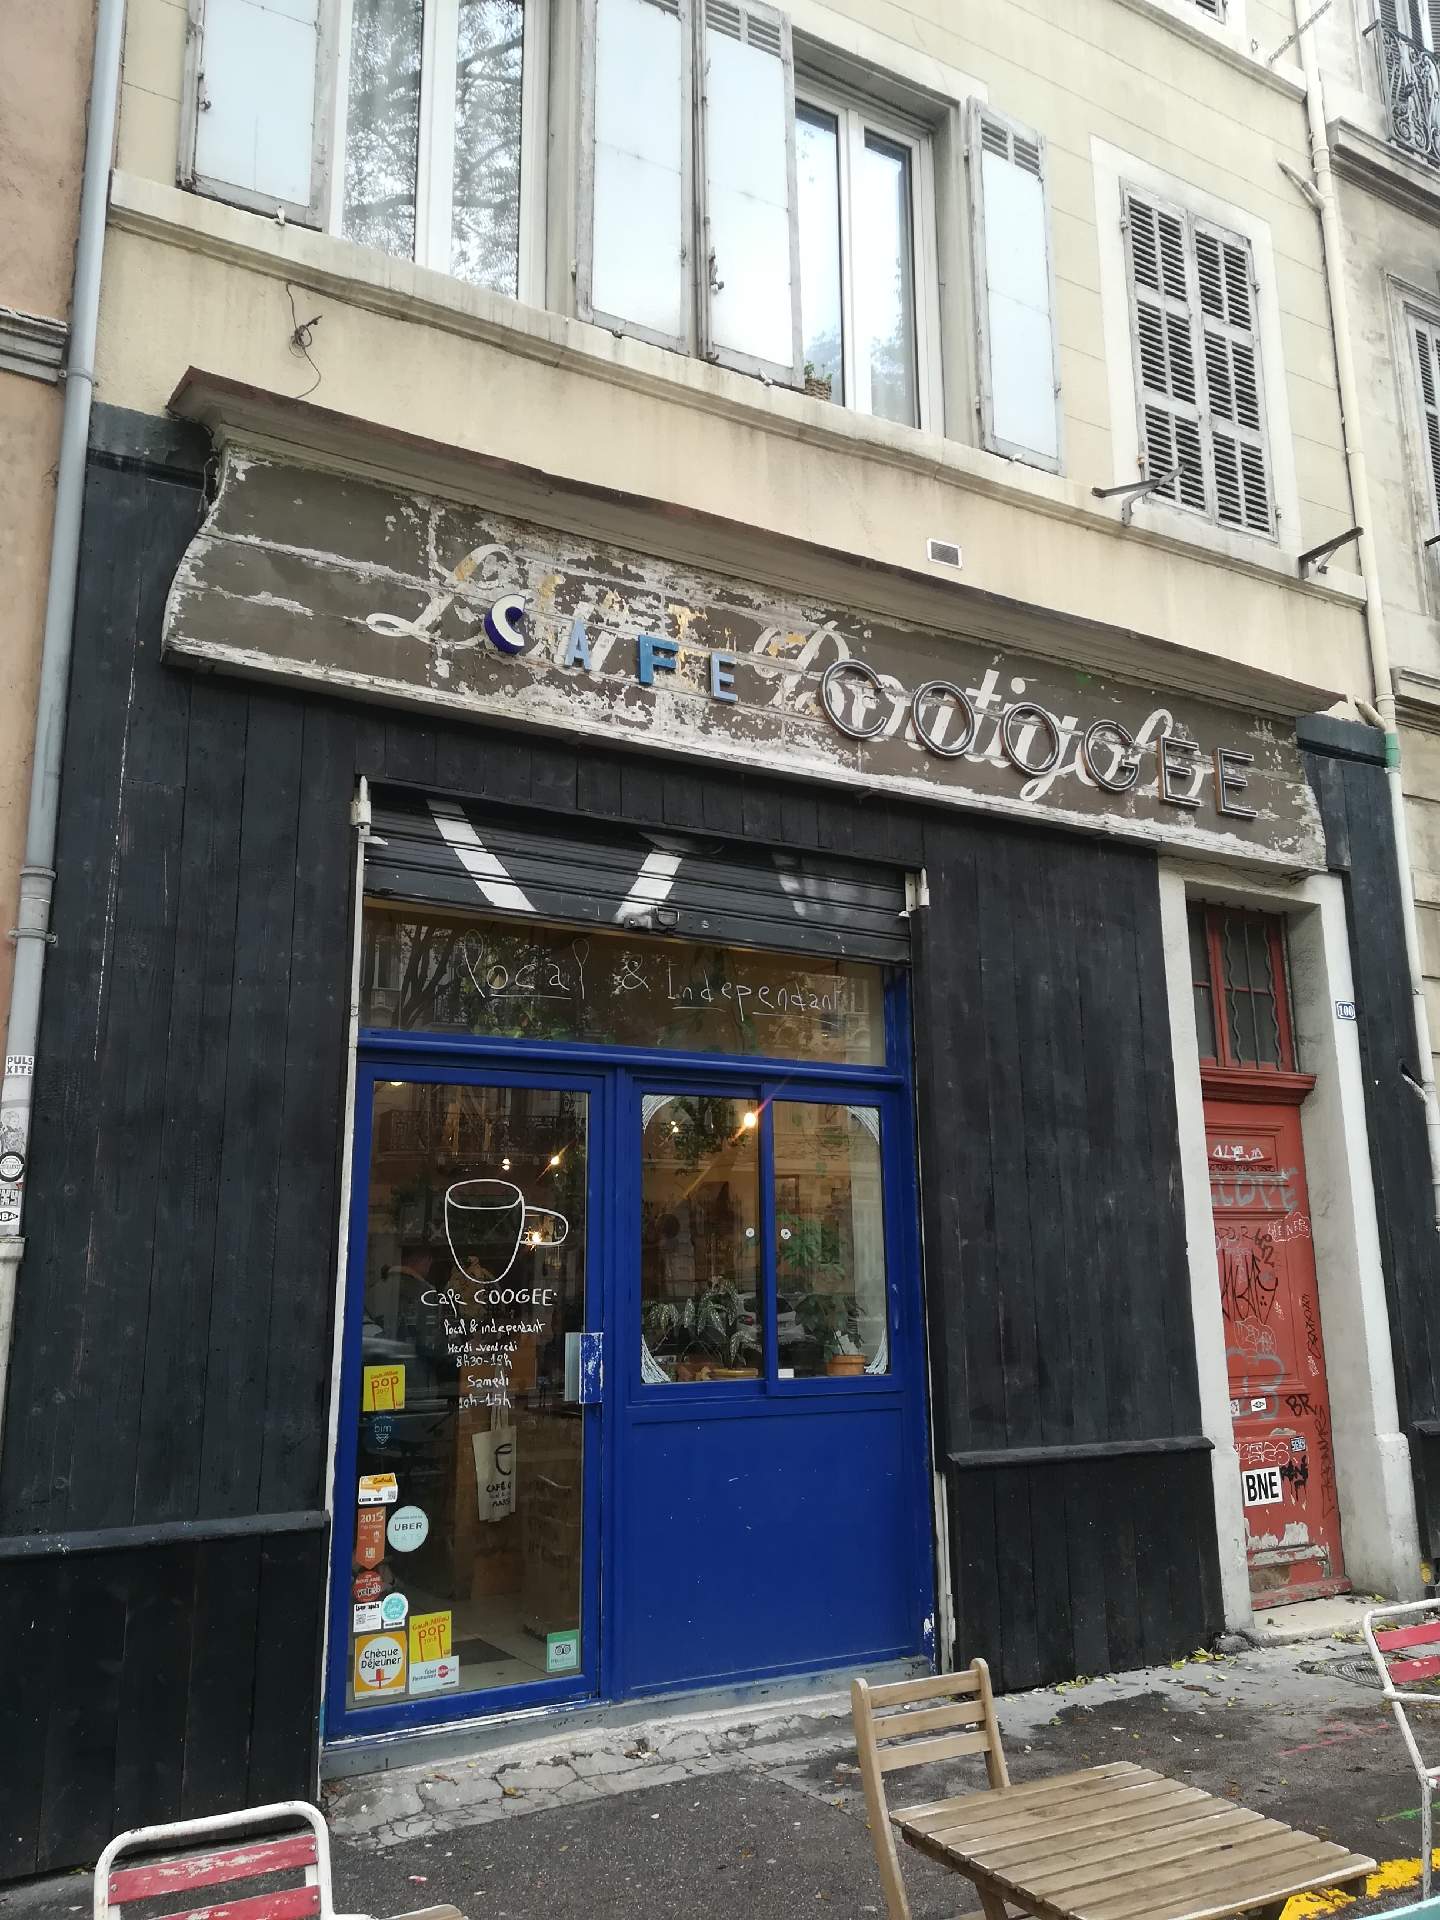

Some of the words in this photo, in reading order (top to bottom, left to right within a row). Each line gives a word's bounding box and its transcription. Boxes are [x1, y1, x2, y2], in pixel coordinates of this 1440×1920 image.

[484, 593, 740, 703] CAFE
[818, 658, 1258, 819] COOGEE
[474, 1288, 554, 1306] COOGEE
[467, 1371, 509, 1388] Samedi
[1245, 1471, 1280, 1502] BNE
[394, 1521, 423, 1531] UBER
[361, 1656, 402, 1669] Déjeuner
[364, 1648, 399, 1660] Chèque
